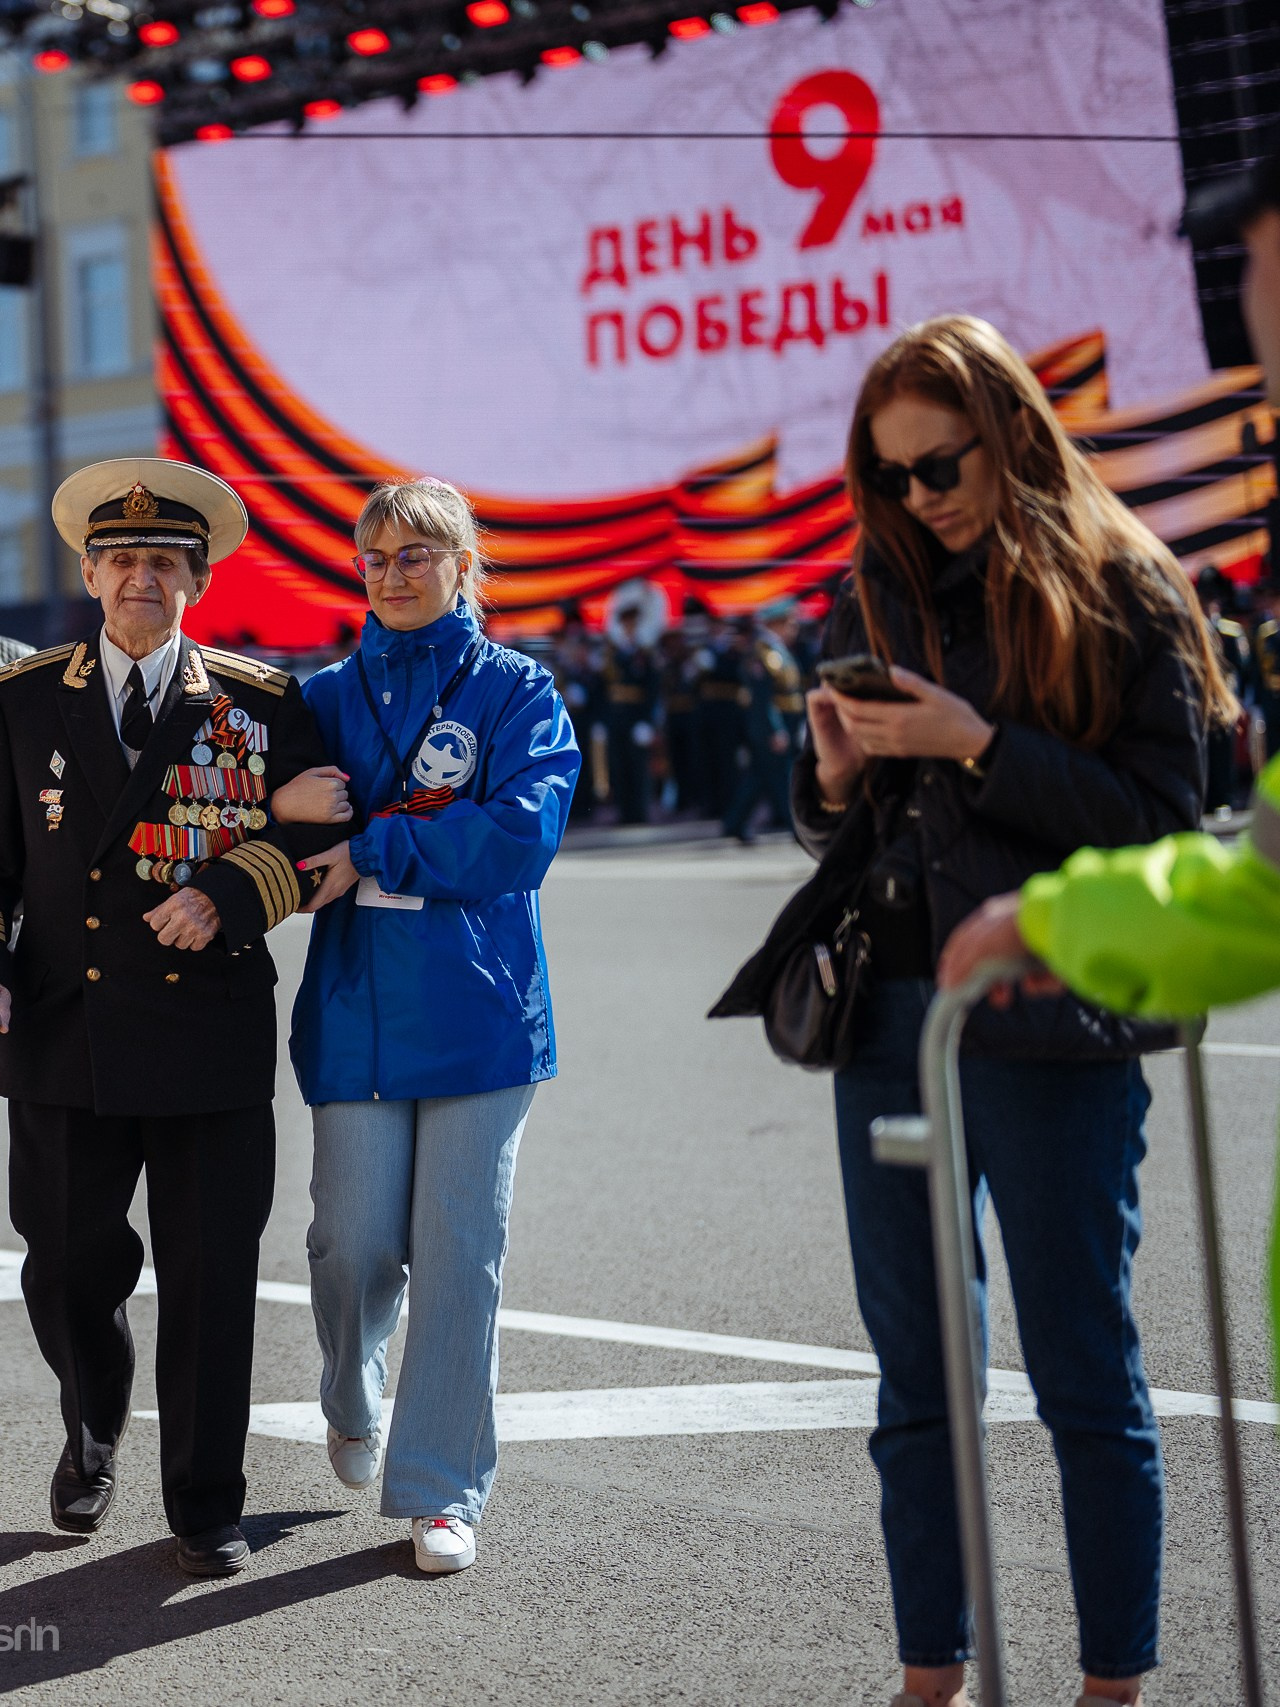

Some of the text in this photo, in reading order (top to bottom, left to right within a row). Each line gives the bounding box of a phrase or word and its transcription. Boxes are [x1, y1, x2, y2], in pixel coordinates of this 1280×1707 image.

[769, 68, 966, 252] 9 мая
[581, 204, 759, 296] ДЕНЬ
[586, 268, 889, 368] ПОБЕДЫ
[233, 710, 245, 728] 9
[455, 726, 476, 756] ПОБЕДЫ
